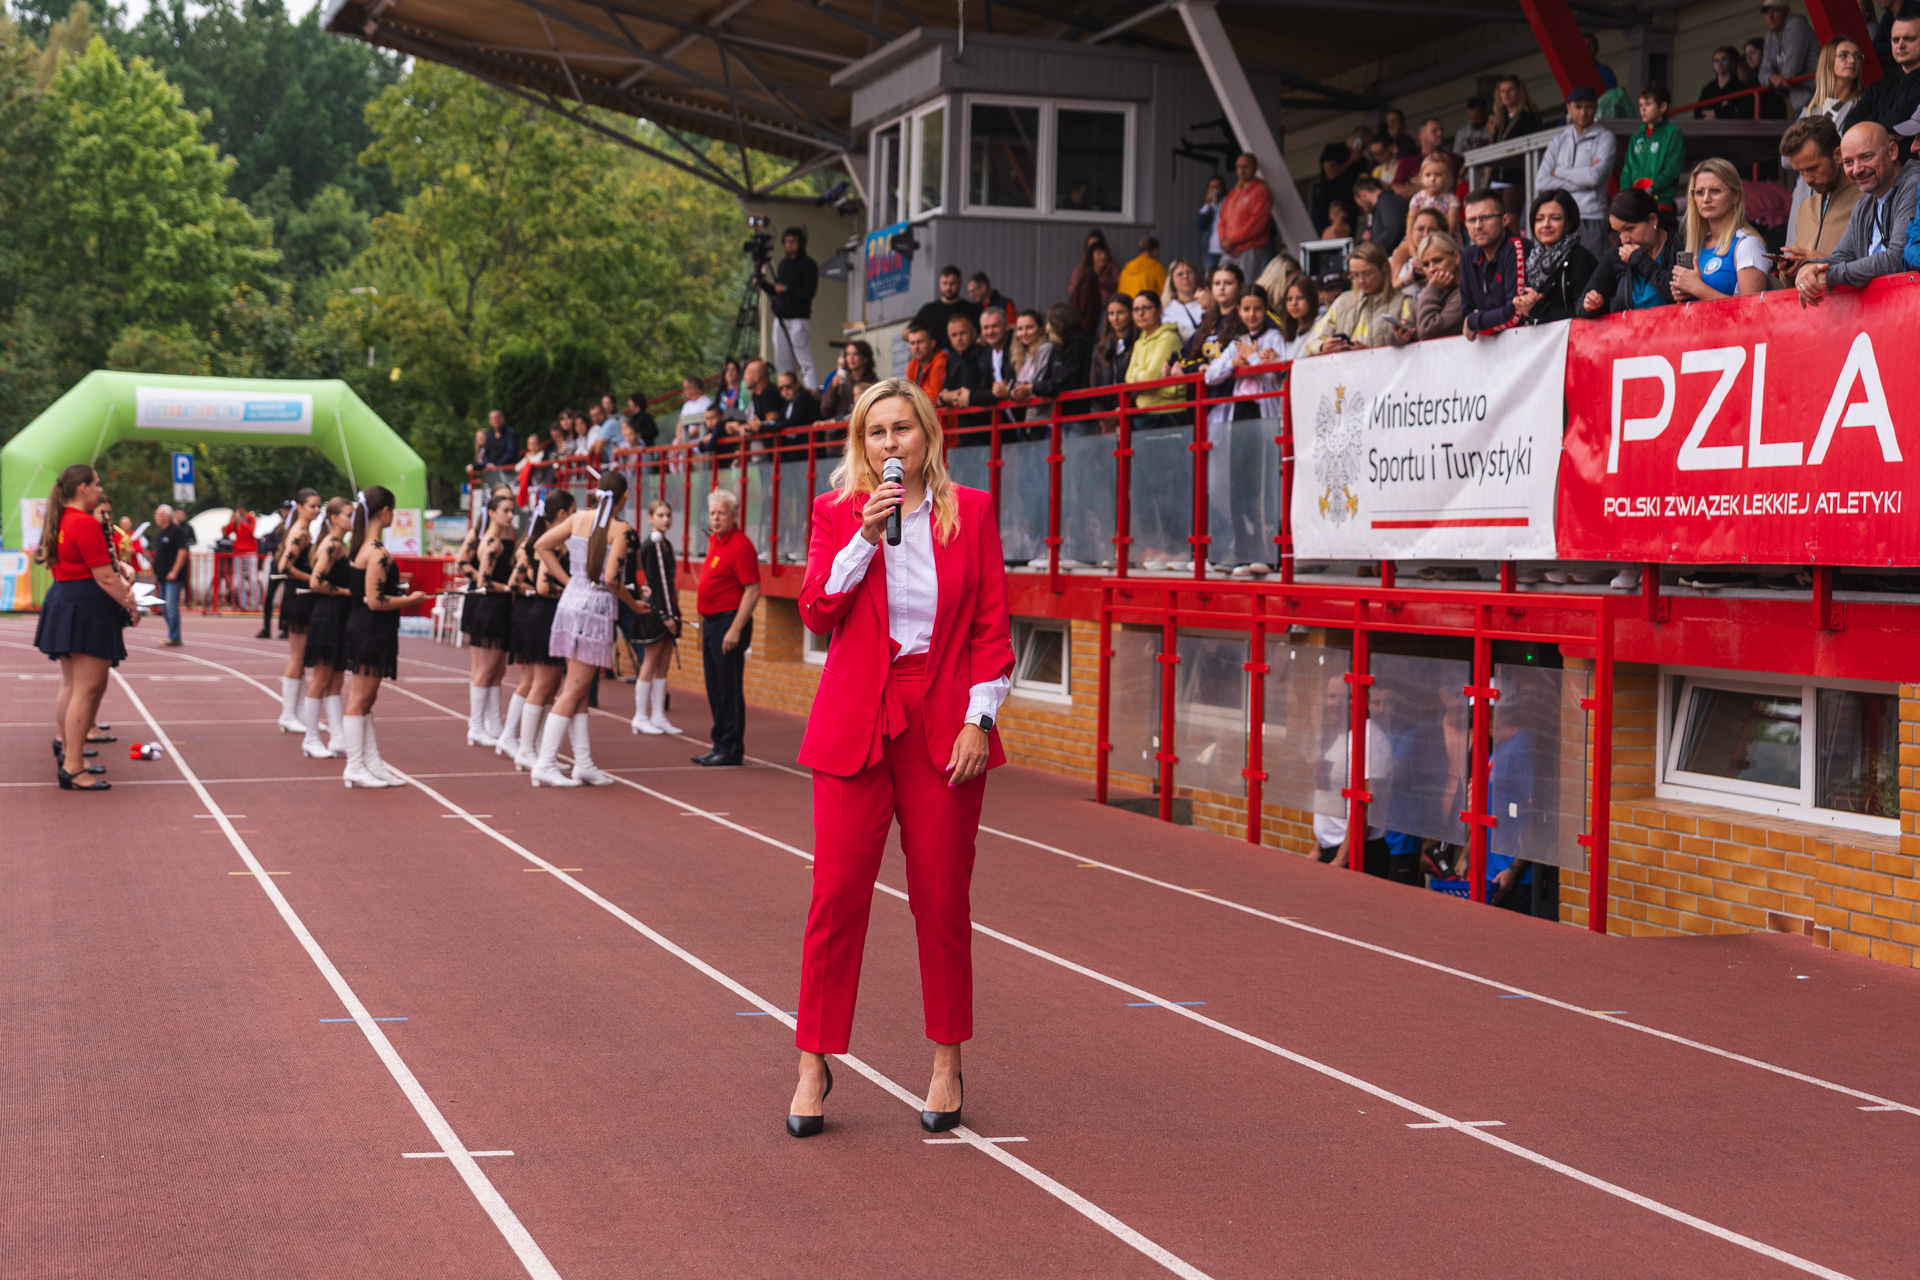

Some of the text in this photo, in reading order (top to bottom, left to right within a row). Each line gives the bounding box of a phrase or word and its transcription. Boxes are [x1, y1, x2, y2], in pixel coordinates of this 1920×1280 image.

[1514, 240, 1525, 294] UNITED
[1368, 389, 1487, 430] Ministerstwo
[1606, 331, 1904, 474] PZLA
[177, 456, 190, 481] P
[1368, 435, 1533, 490] Sportu i Turystyki
[1604, 490, 1902, 520] POLSKI ZWIĄZEK LEKKIEJ ATLETYKI
